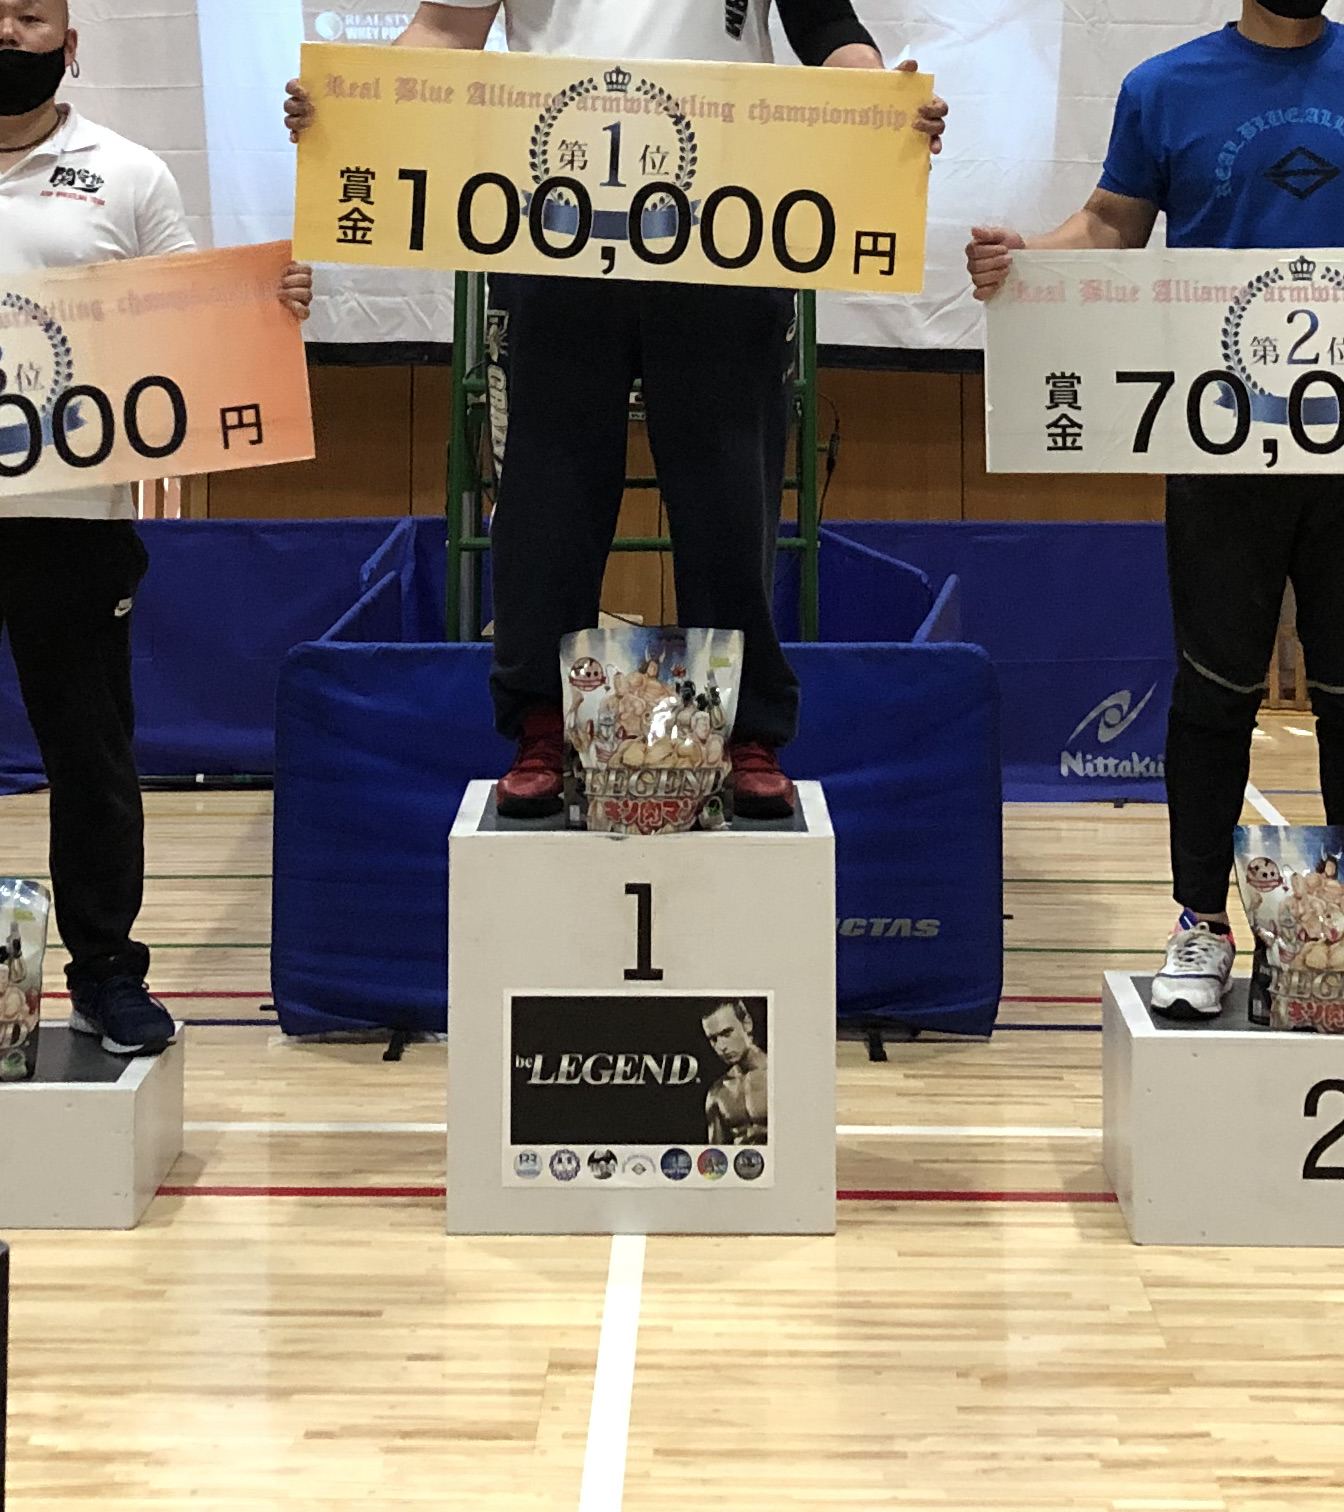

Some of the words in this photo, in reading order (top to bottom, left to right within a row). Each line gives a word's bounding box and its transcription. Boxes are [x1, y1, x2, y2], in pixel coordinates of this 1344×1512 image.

[323, 73, 382, 101] Real
[394, 75, 455, 105] Blue
[747, 97, 907, 132] championship
[557, 120, 671, 188] 第1位
[336, 165, 376, 247] 賞金
[396, 168, 836, 275] 100,000
[853, 230, 897, 277] 円
[1079, 279, 1141, 307] Blue
[219, 401, 264, 451] 円
[1045, 371, 1084, 453] 賞金
[623, 882, 664, 981] 1
